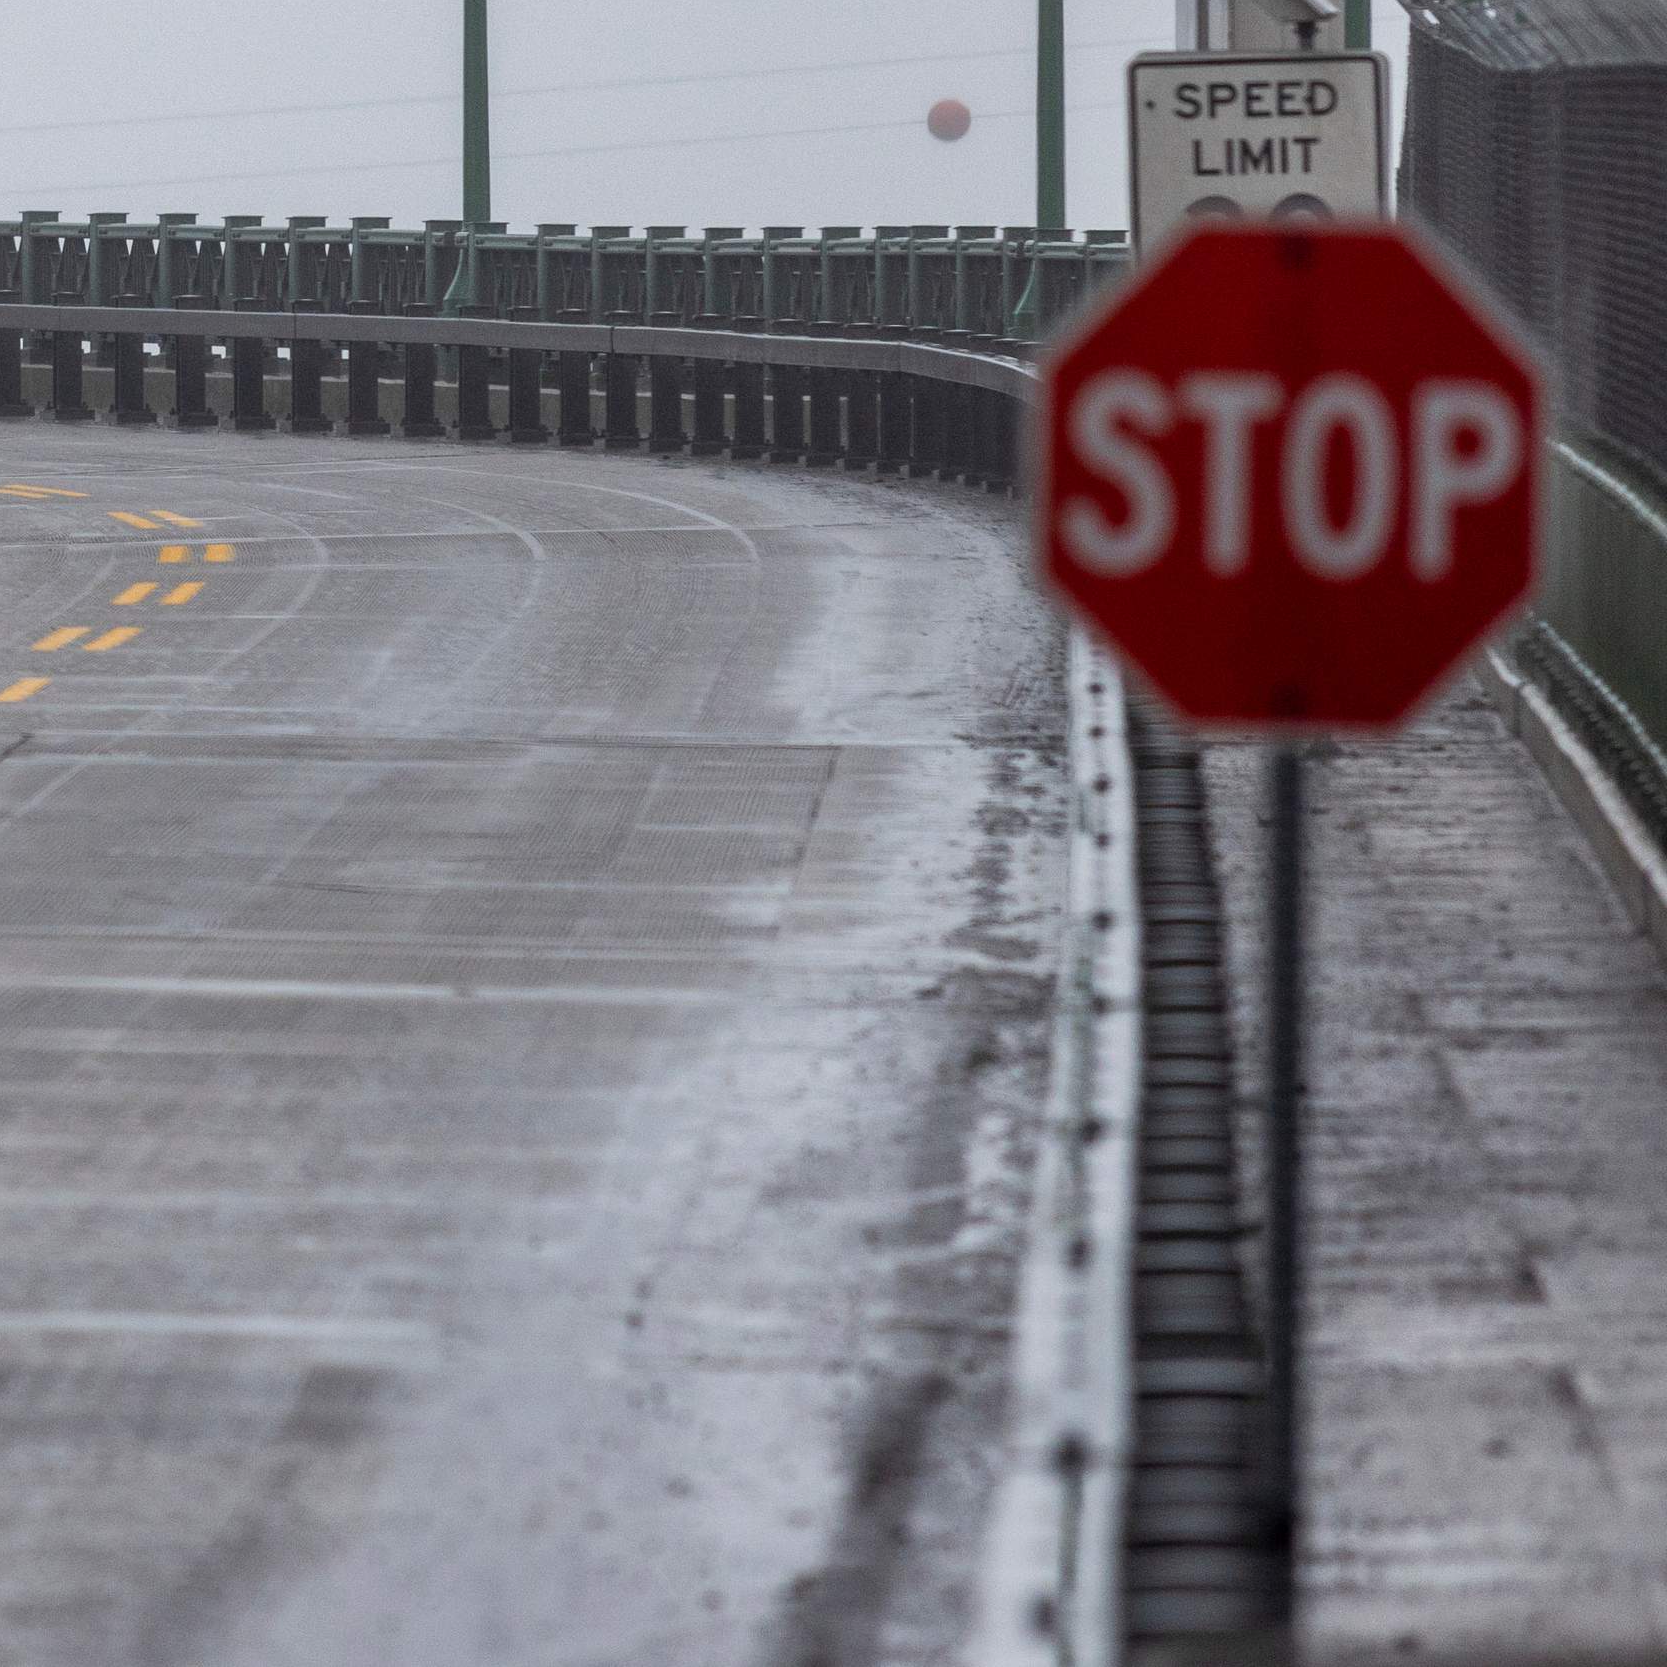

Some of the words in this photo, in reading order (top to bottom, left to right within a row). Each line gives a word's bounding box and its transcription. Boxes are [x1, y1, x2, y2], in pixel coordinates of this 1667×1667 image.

[1172, 80, 1339, 120] SPEED
[1191, 137, 1321, 176] LIMIT
[1057, 365, 1525, 583] STOP
